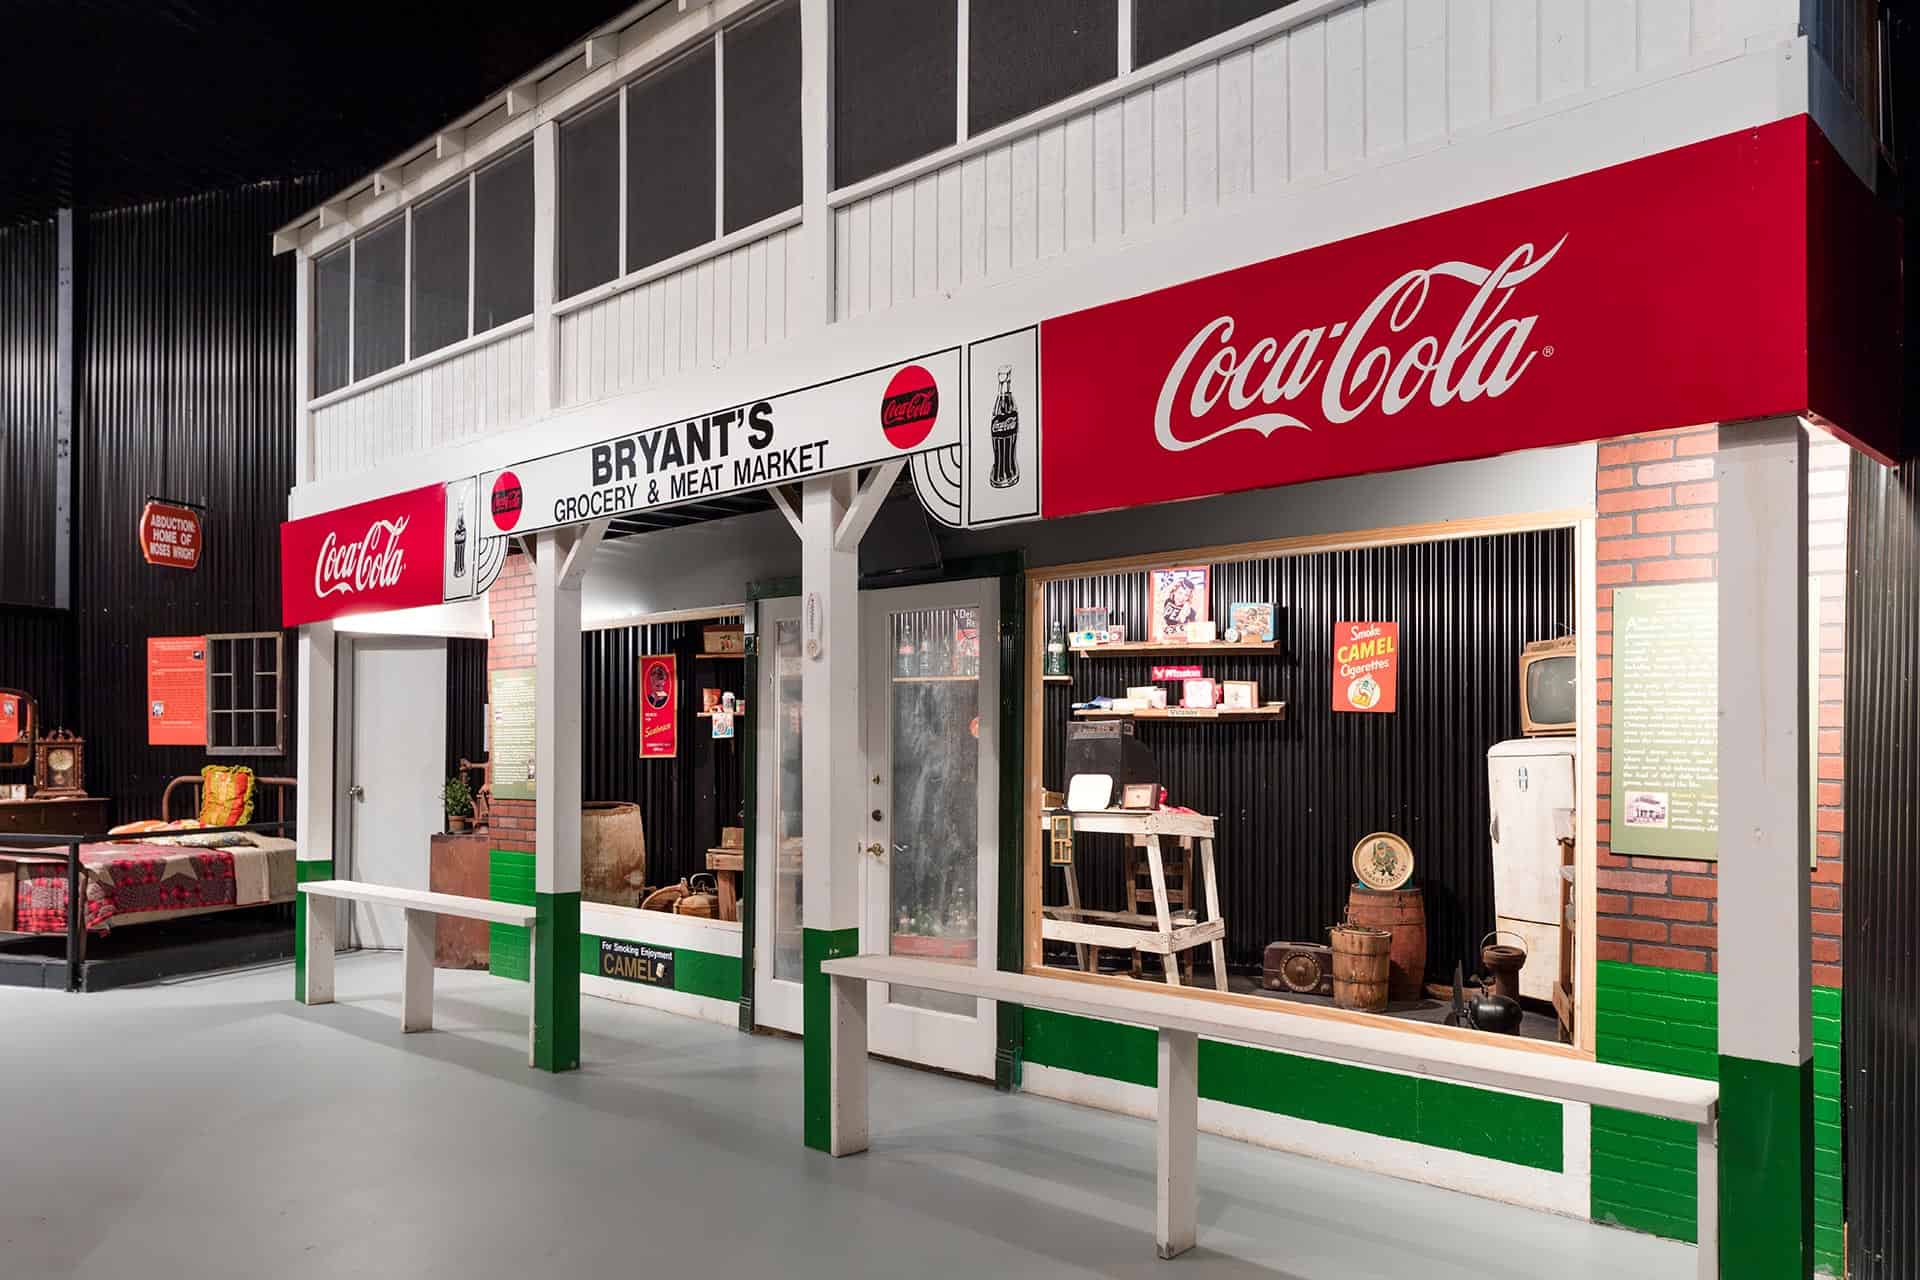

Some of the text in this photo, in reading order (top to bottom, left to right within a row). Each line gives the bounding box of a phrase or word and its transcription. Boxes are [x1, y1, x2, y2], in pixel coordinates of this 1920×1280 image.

[1153, 231, 1569, 452] Coca-Cola
[591, 402, 775, 487] BRYANT'S
[554, 483, 638, 522] GROCERY
[647, 479, 660, 503] &
[670, 464, 723, 499] MEAT
[733, 440, 829, 487] MARKET
[153, 528, 192, 545] HOME OF
[315, 515, 410, 598] Coca-Cola
[1350, 624, 1381, 641] Smoke
[1337, 636, 1394, 664] CAMEL
[1340, 659, 1390, 679] Cigarettes
[602, 941, 673, 961] For Smoking Enjoyment
[603, 953, 657, 981] CAMEL
